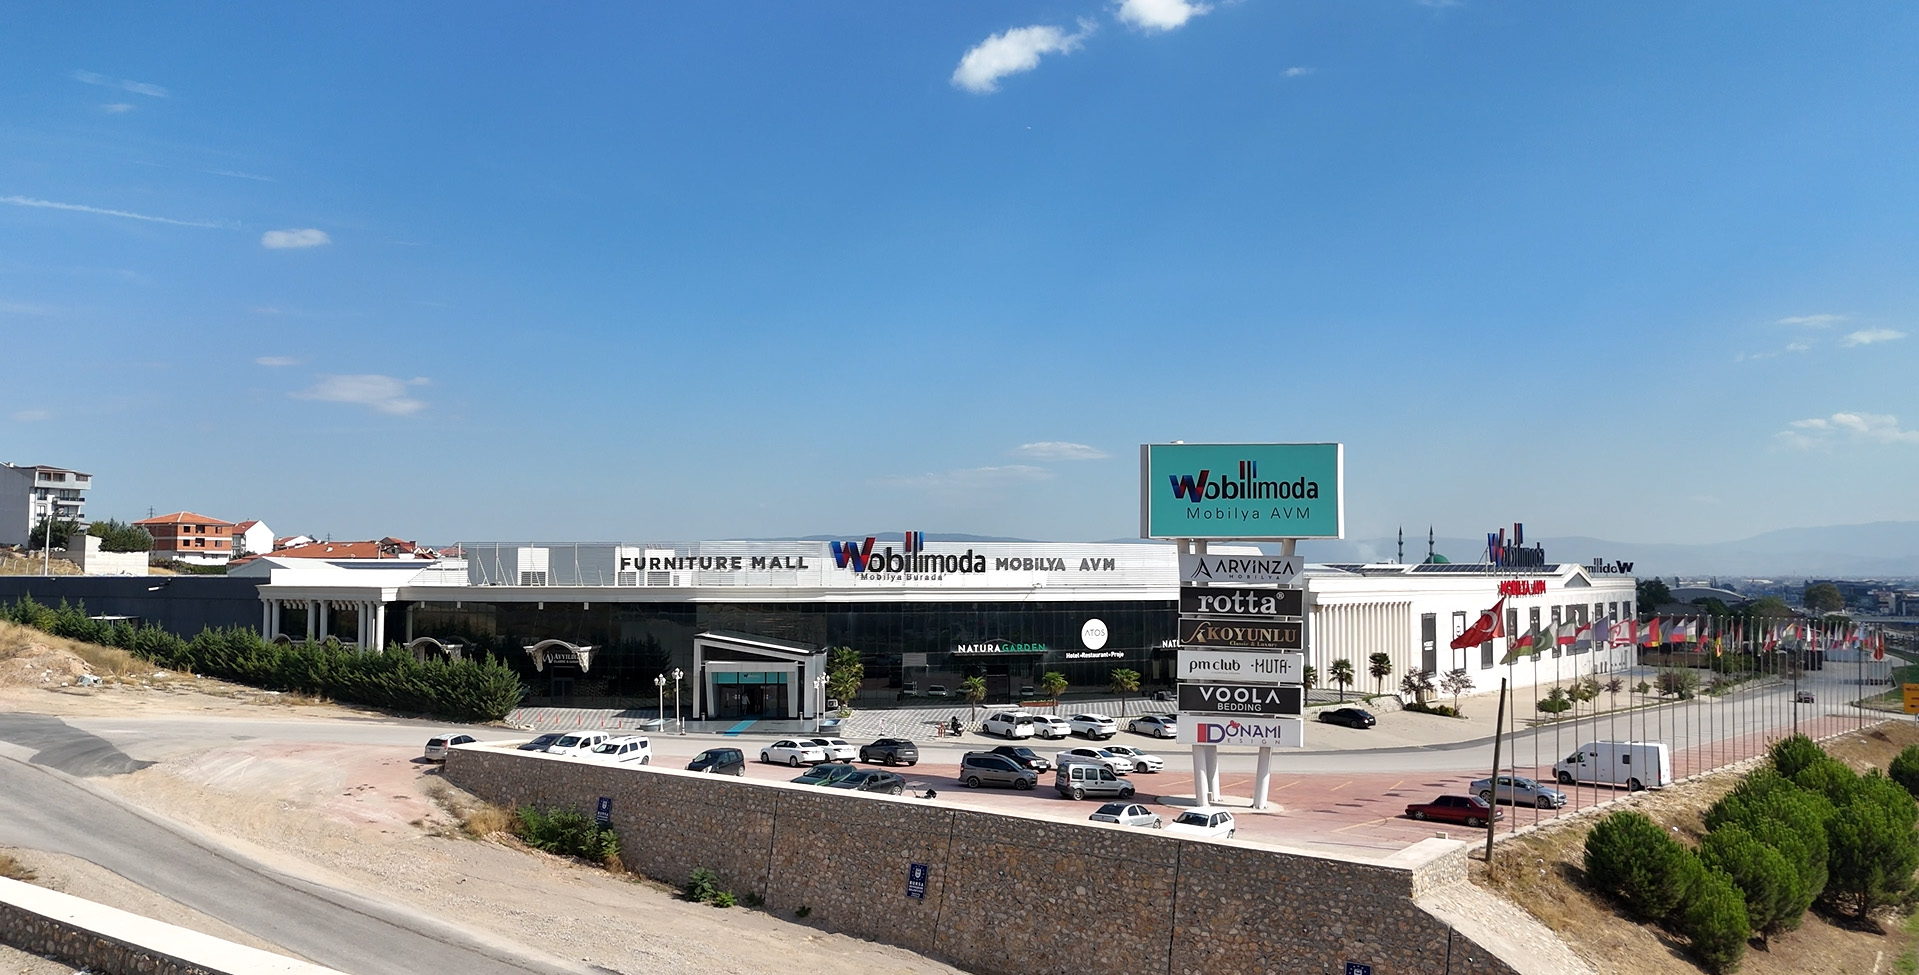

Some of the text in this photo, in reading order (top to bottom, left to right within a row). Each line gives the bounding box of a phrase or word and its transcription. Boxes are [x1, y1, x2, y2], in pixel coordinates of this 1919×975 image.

[1169, 460, 1319, 503] Wobilimoda
[1186, 507, 1310, 521] Mobilya AVM
[829, 531, 986, 573] Wobilimoda
[620, 556, 809, 571] FURNITURE MALL
[1078, 557, 1116, 571] AVM
[1084, 628, 1106, 637] ATOS
[1206, 626, 1297, 643] KOYUNLU
[1199, 686, 1281, 704] VOOLA
[1217, 702, 1262, 712] BEDDING
